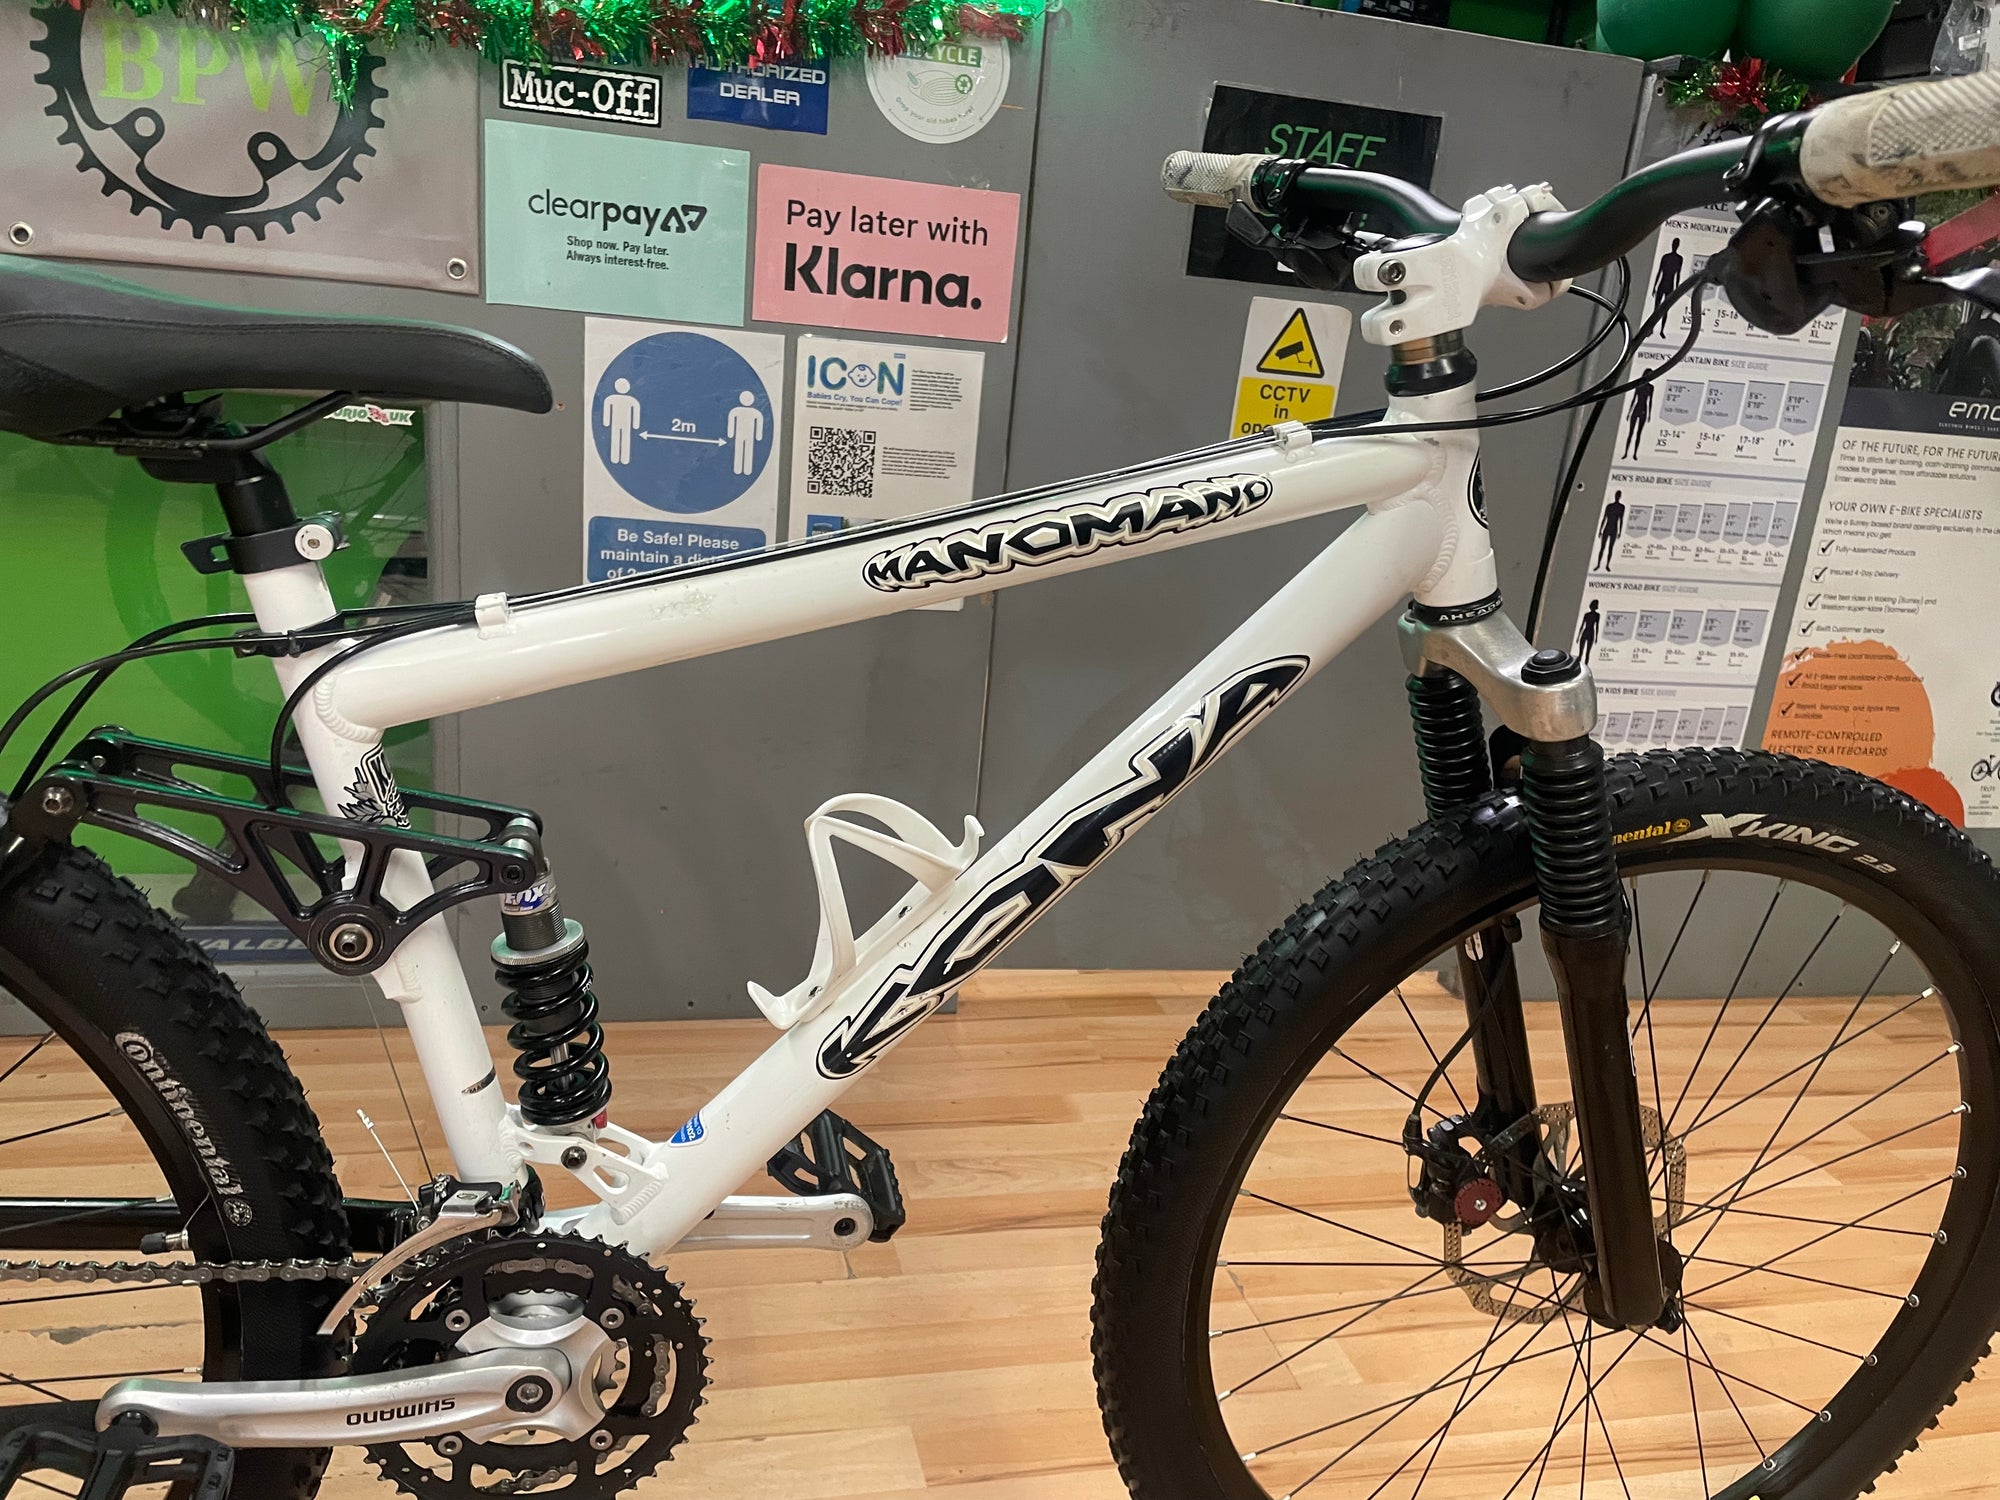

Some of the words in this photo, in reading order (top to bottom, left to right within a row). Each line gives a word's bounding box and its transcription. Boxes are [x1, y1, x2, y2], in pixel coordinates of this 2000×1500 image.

[99, 18, 326, 116] BPW
[510, 68, 652, 117] Muc-Off
[720, 82, 800, 106] DEALER
[1264, 123, 1386, 168] STAFF
[528, 188, 662, 237] clearpay
[787, 199, 842, 236] Pay
[851, 205, 918, 238] later
[927, 216, 988, 246] with
[1665, 219, 1690, 229] MEN'S
[1690, 221, 1729, 234] MOUNTAIN
[566, 235, 593, 249] Shop
[596, 241, 620, 251] now.
[623, 241, 641, 256] Pay
[643, 244, 670, 256] later.
[566, 250, 601, 264] Always
[604, 254, 670, 271] interest-free.
[784, 242, 982, 310] Klarna.
[1637, 351, 1672, 363] WOMEN'S
[1677, 354, 1712, 366] OUNTAIN
[1712, 357, 1730, 368] BIKE
[1730, 359, 1746, 369] SIZE
[1747, 361, 1769, 371] GUIDE
[806, 391, 832, 401] Babies
[833, 393, 848, 402] Cry,
[851, 395, 864, 403] You
[864, 396, 880, 404] Can
[1260, 384, 1311, 403] CCTV
[389, 411, 409, 423] UK
[1273, 404, 1289, 420] in
[671, 418, 696, 433] 2m
[1655, 438, 1667, 447] XS
[1696, 441, 1702, 450] S
[1842, 439, 1858, 450] OF
[1861, 441, 1879, 452] THE
[1882, 442, 1920, 456] FUTURE,
[1923, 445, 1944, 457] FOR
[1946, 447, 1965, 459] THE
[1611, 473, 1635, 483] MEN'S
[1635, 475, 1655, 484] ROAD
[1656, 477, 1673, 485] BIKE
[1828, 500, 1858, 512] YOUR
[1859, 503, 1887, 515] OWN
[1889, 505, 1922, 517] E-BIKE
[1923, 507, 1984, 521] SPECIALISTS
[617, 528, 638, 543] Be
[643, 530, 683, 546] Safe!
[687, 534, 740, 550] Please
[600, 549, 669, 564] maintain
[673, 555, 683, 565] a
[606, 567, 624, 579] of
[1588, 581, 1622, 591] WOMEN'S
[1623, 583, 1643, 591] ROAD
[1643, 584, 1662, 593] BIKE
[1605, 687, 1621, 695] KIDS
[1622, 688, 1639, 696] BIKE
[1771, 729, 1883, 742] REMOTE-CONTROLLED
[1816, 745, 1888, 757] SKATEBOARDS
[504, 882, 546, 905] FOX
[114, 1031, 244, 1196] Continental
[346, 1397, 456, 1426] SHIMANO
